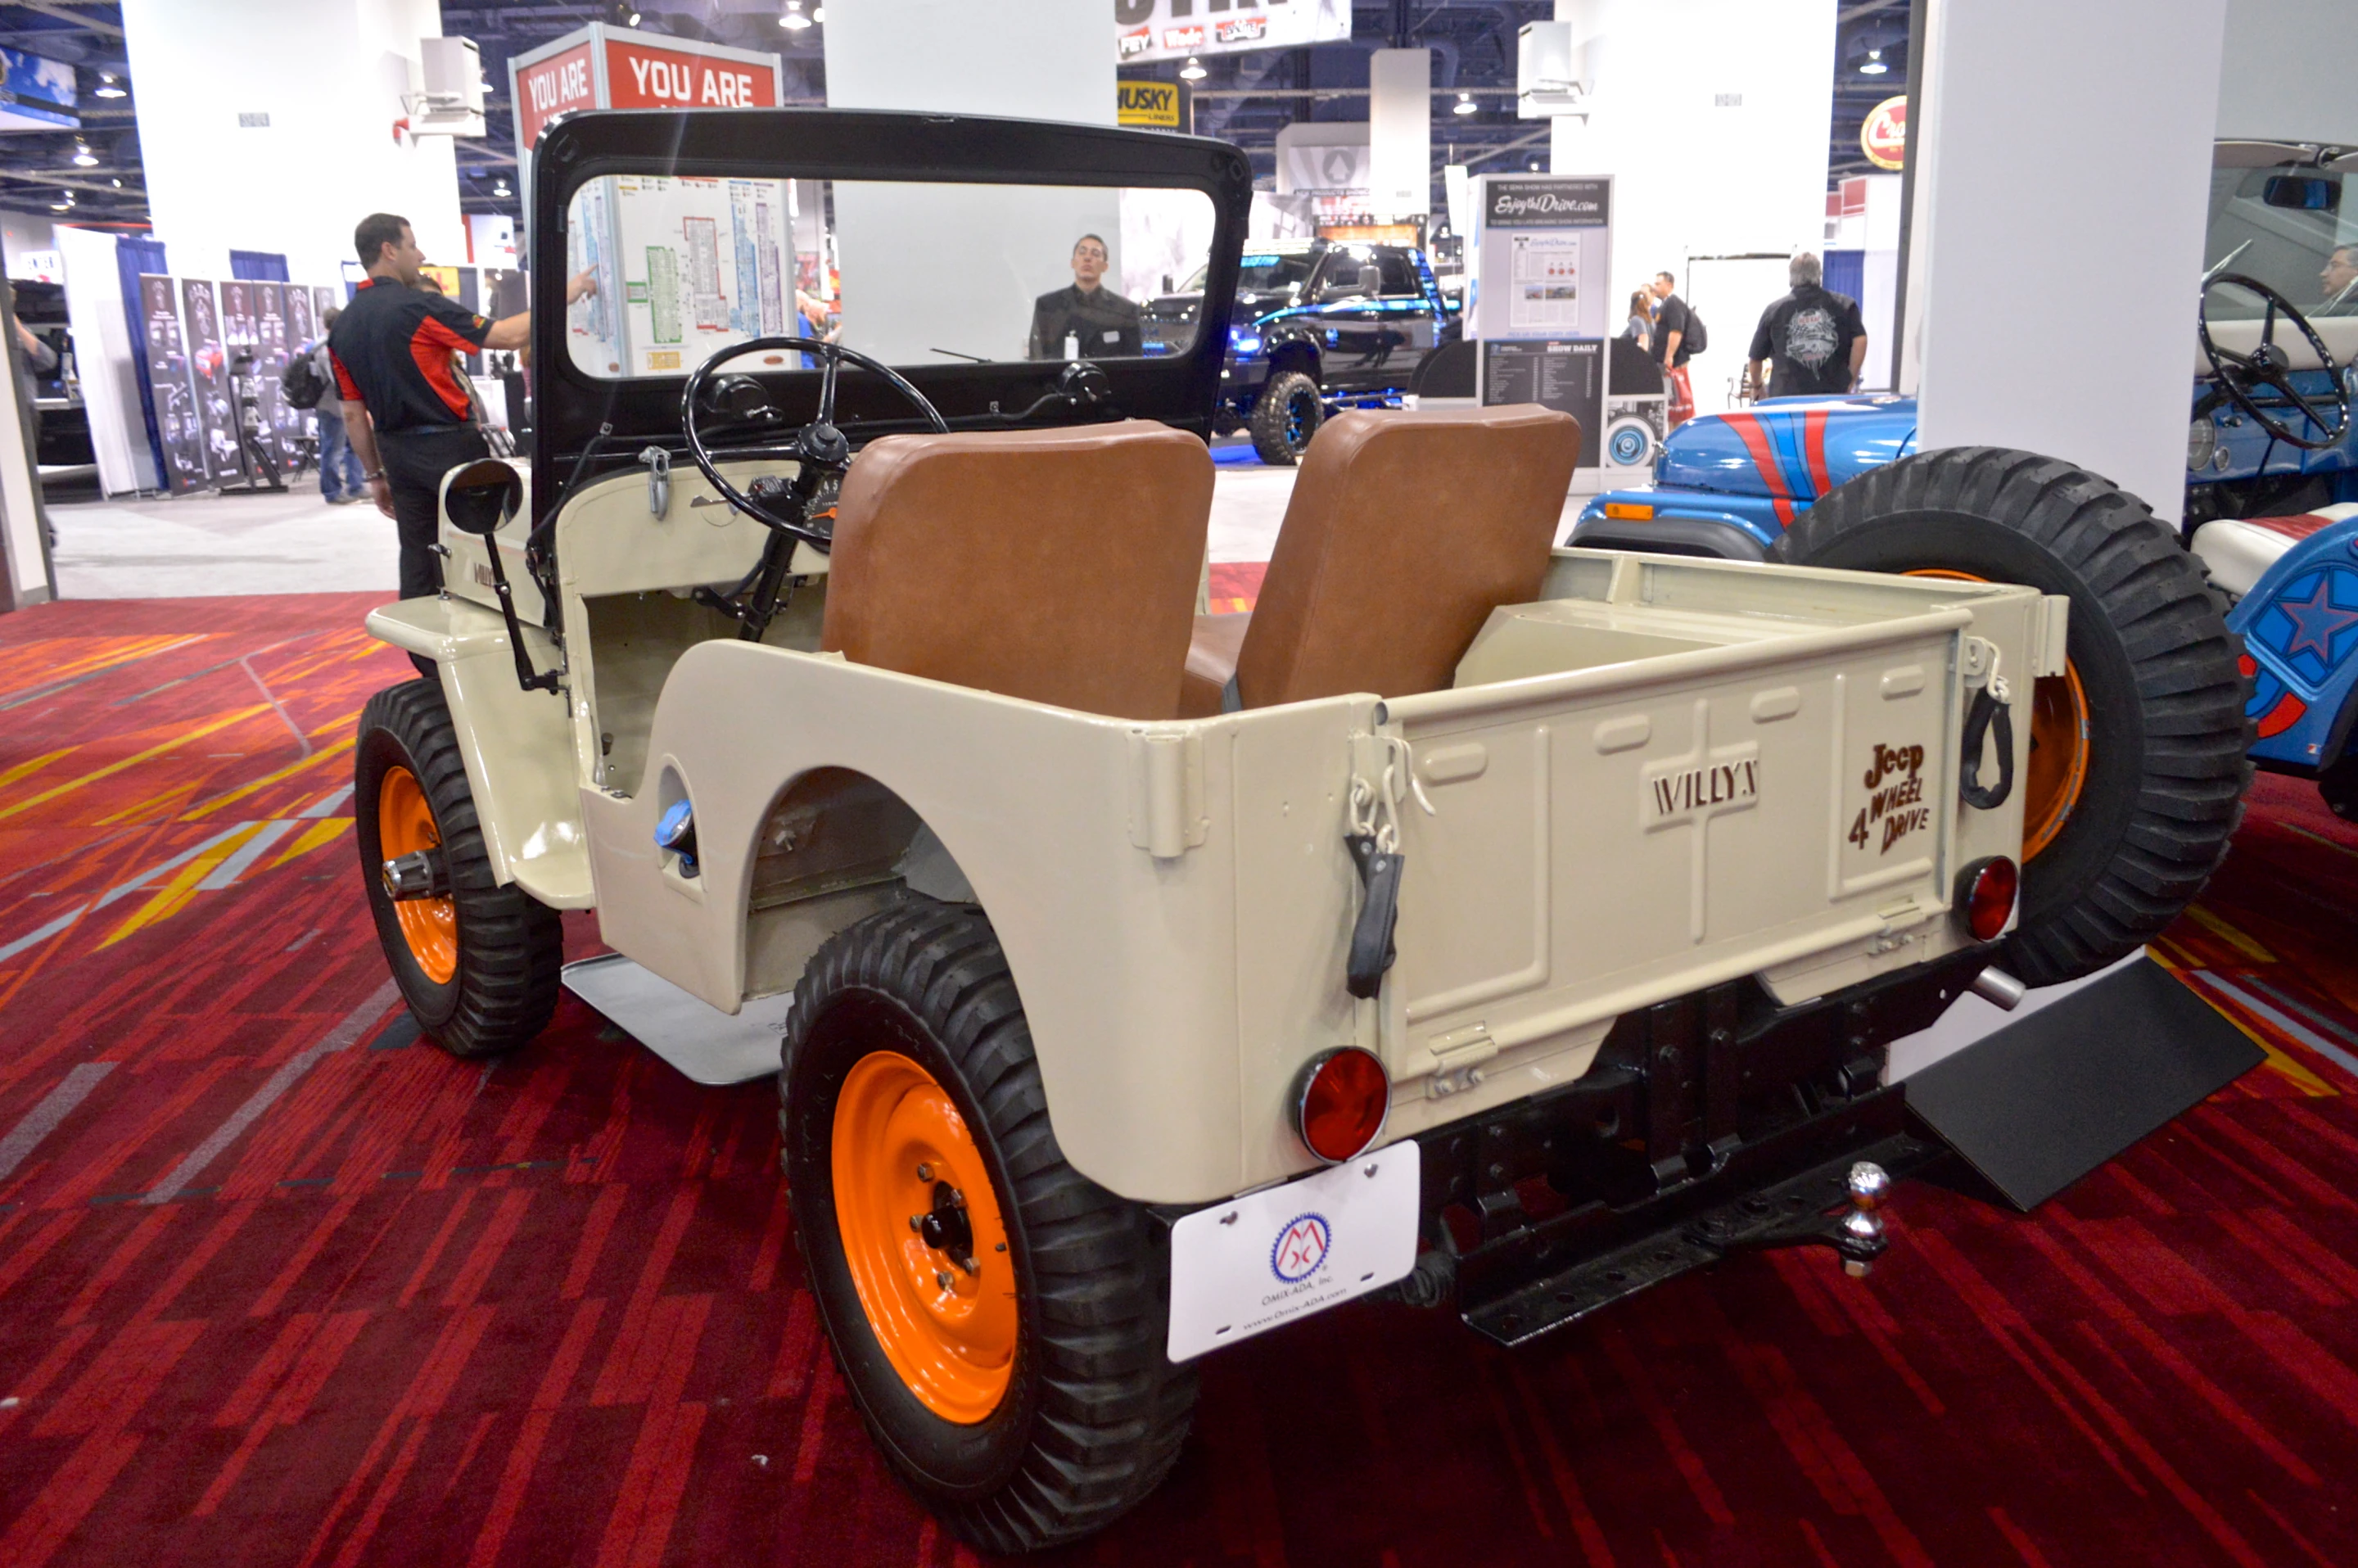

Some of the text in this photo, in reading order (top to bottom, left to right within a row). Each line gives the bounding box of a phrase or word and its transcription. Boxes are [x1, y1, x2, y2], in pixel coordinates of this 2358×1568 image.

[1121, 34, 1150, 52] FEY
[528, 58, 589, 112] YOU ARE
[629, 56, 753, 107] YOU ARE
[1494, 193, 1598, 215] EnjoytheDrive.com
[1573, 344, 1598, 352] DAILY
[1864, 743, 1924, 789] Jeep
[1848, 778, 1922, 850] 4 WHEEL
[1880, 807, 1930, 856] DRIVE
[1244, 1288, 1347, 1330] www.Omix-ADA.com
